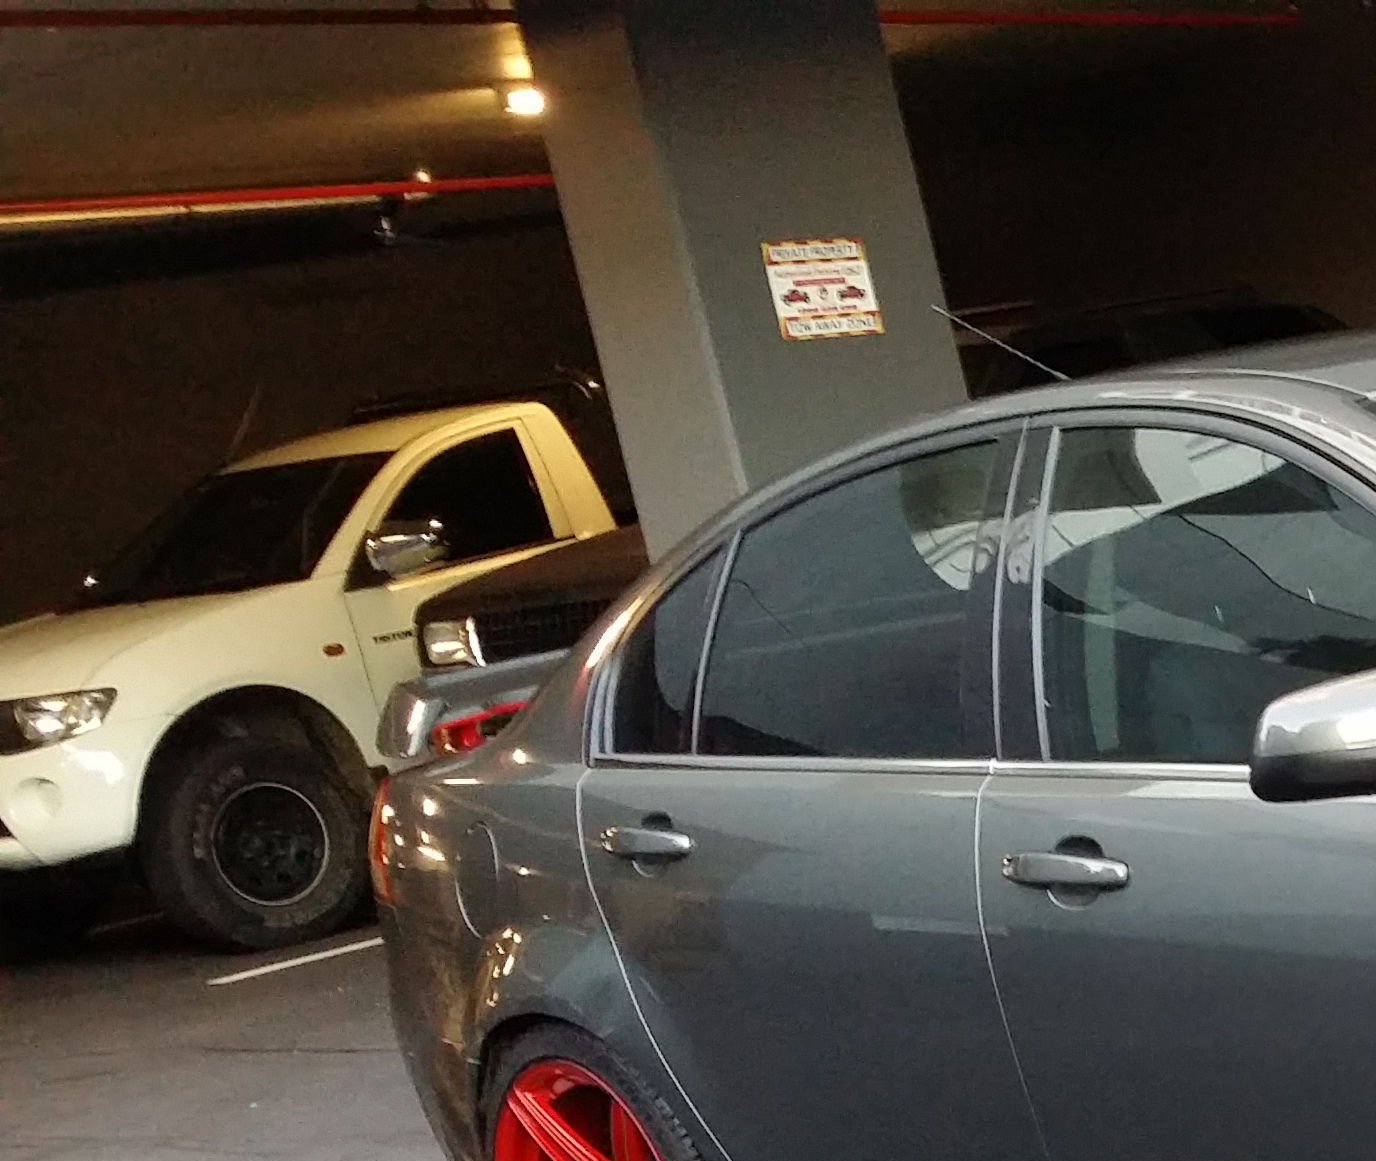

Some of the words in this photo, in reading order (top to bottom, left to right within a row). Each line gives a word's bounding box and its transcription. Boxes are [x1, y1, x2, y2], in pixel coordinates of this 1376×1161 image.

[771, 246, 807, 258] PRIVATE
[809, 244, 853, 257] PROPERTY
[788, 321, 812, 332] TOW
[815, 319, 844, 331] AWAY
[846, 316, 874, 329] ZONE
